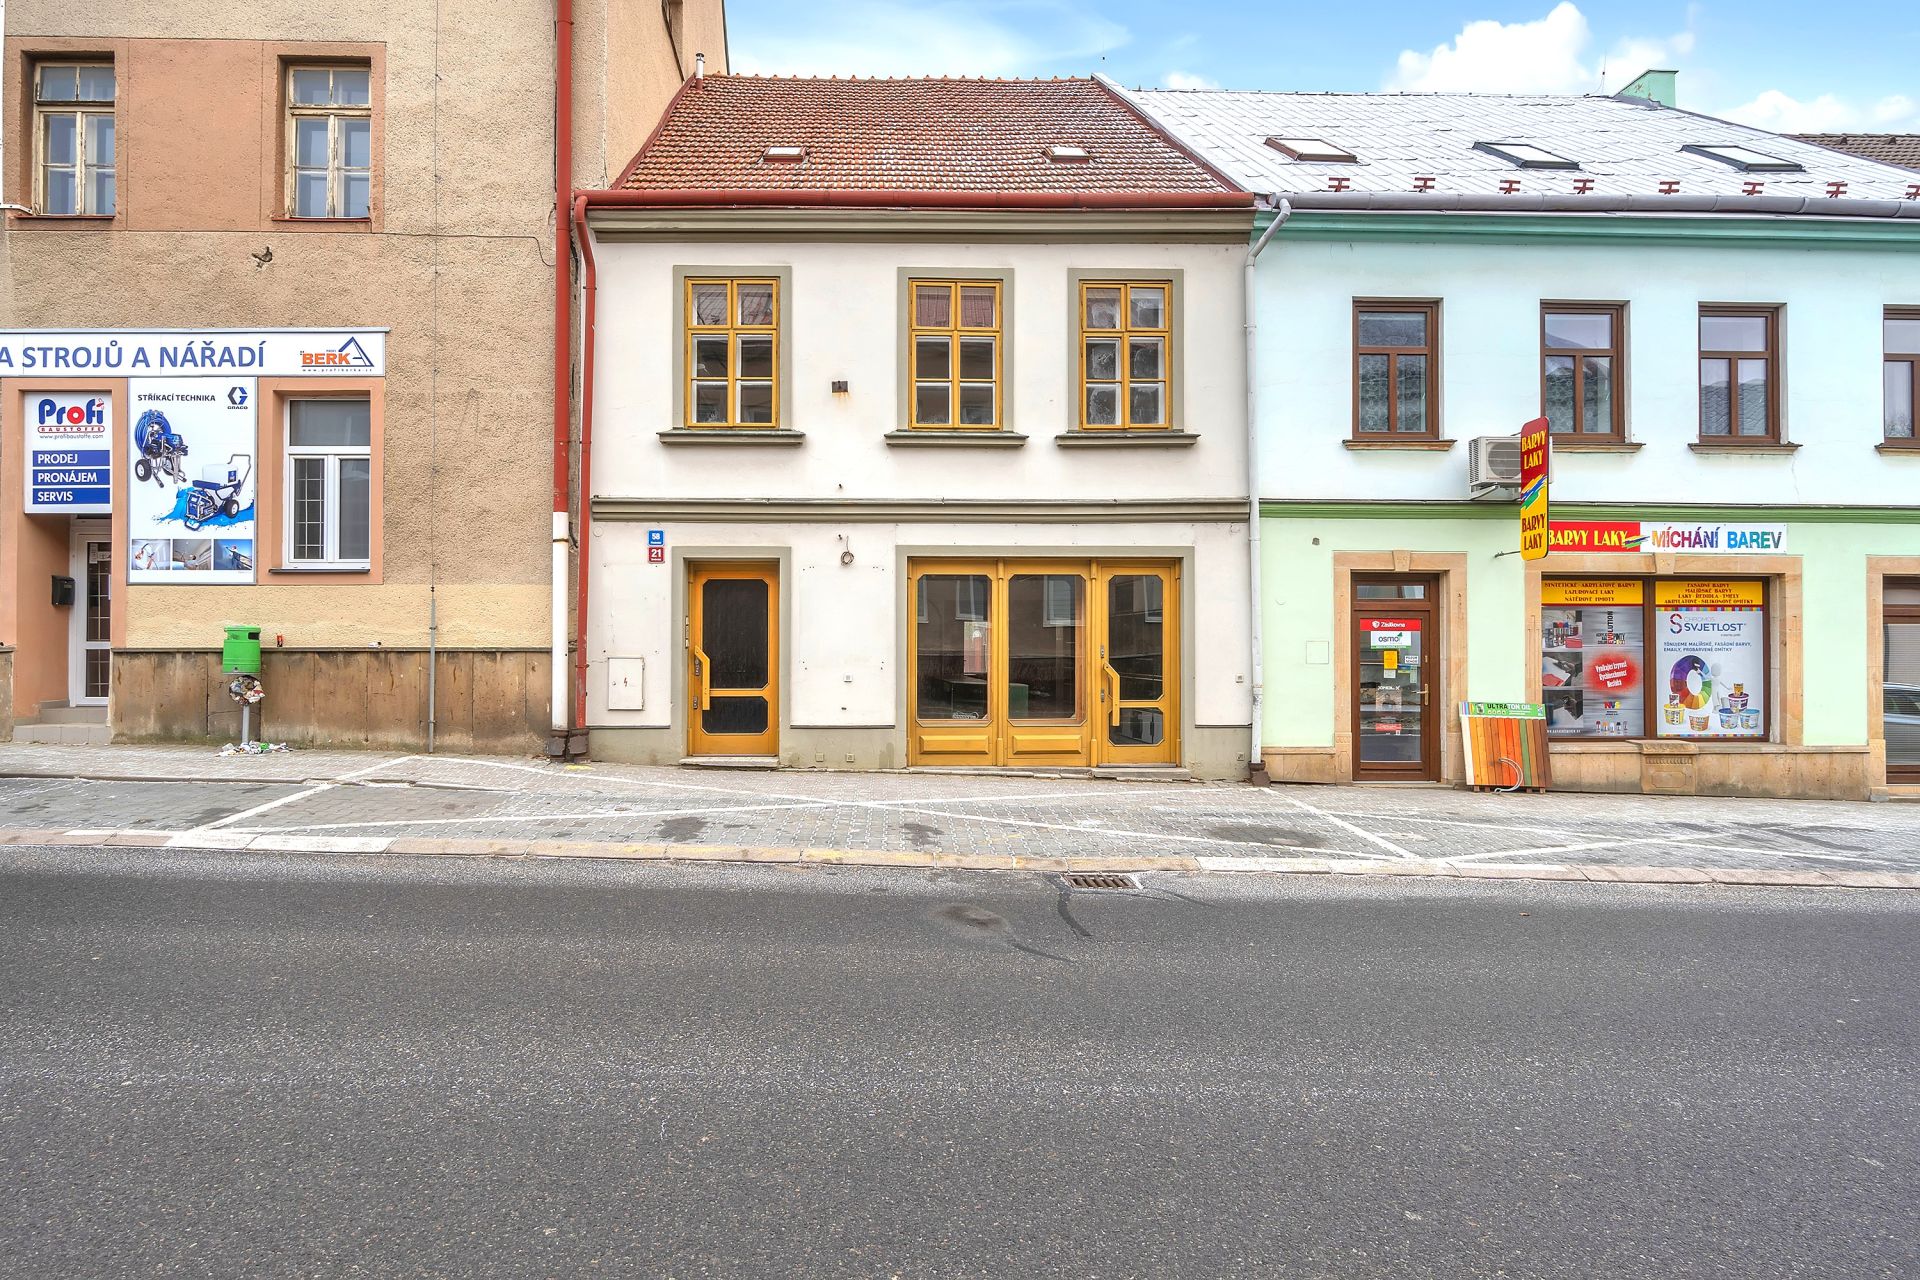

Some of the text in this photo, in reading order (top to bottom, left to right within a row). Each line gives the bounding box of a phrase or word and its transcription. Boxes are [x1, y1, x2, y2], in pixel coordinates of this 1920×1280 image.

[22, 340, 123, 368] STROJŮ
[131, 347, 151, 368] A
[160, 340, 267, 368] NÁŘADÍ
[137, 393, 216, 402] STŘÍKACÍ TECHNIKA
[38, 397, 104, 425] Profi
[1521, 430, 1546, 452] BARVY
[37, 453, 78, 464] PRODEJ
[1523, 450, 1543, 470] LAKY
[37, 470, 98, 483] PRONÁJEM
[37, 491, 74, 502] SERVIS
[1521, 513, 1546, 533] BARVY
[1523, 532, 1543, 551] LAKY
[1549, 530, 1628, 546] BARVY LAKY
[1651, 527, 1782, 549] MÍCHÁNÍ BAREV
[651, 549, 661, 558] 21
[1684, 622, 1744, 632] SVJETLOST
